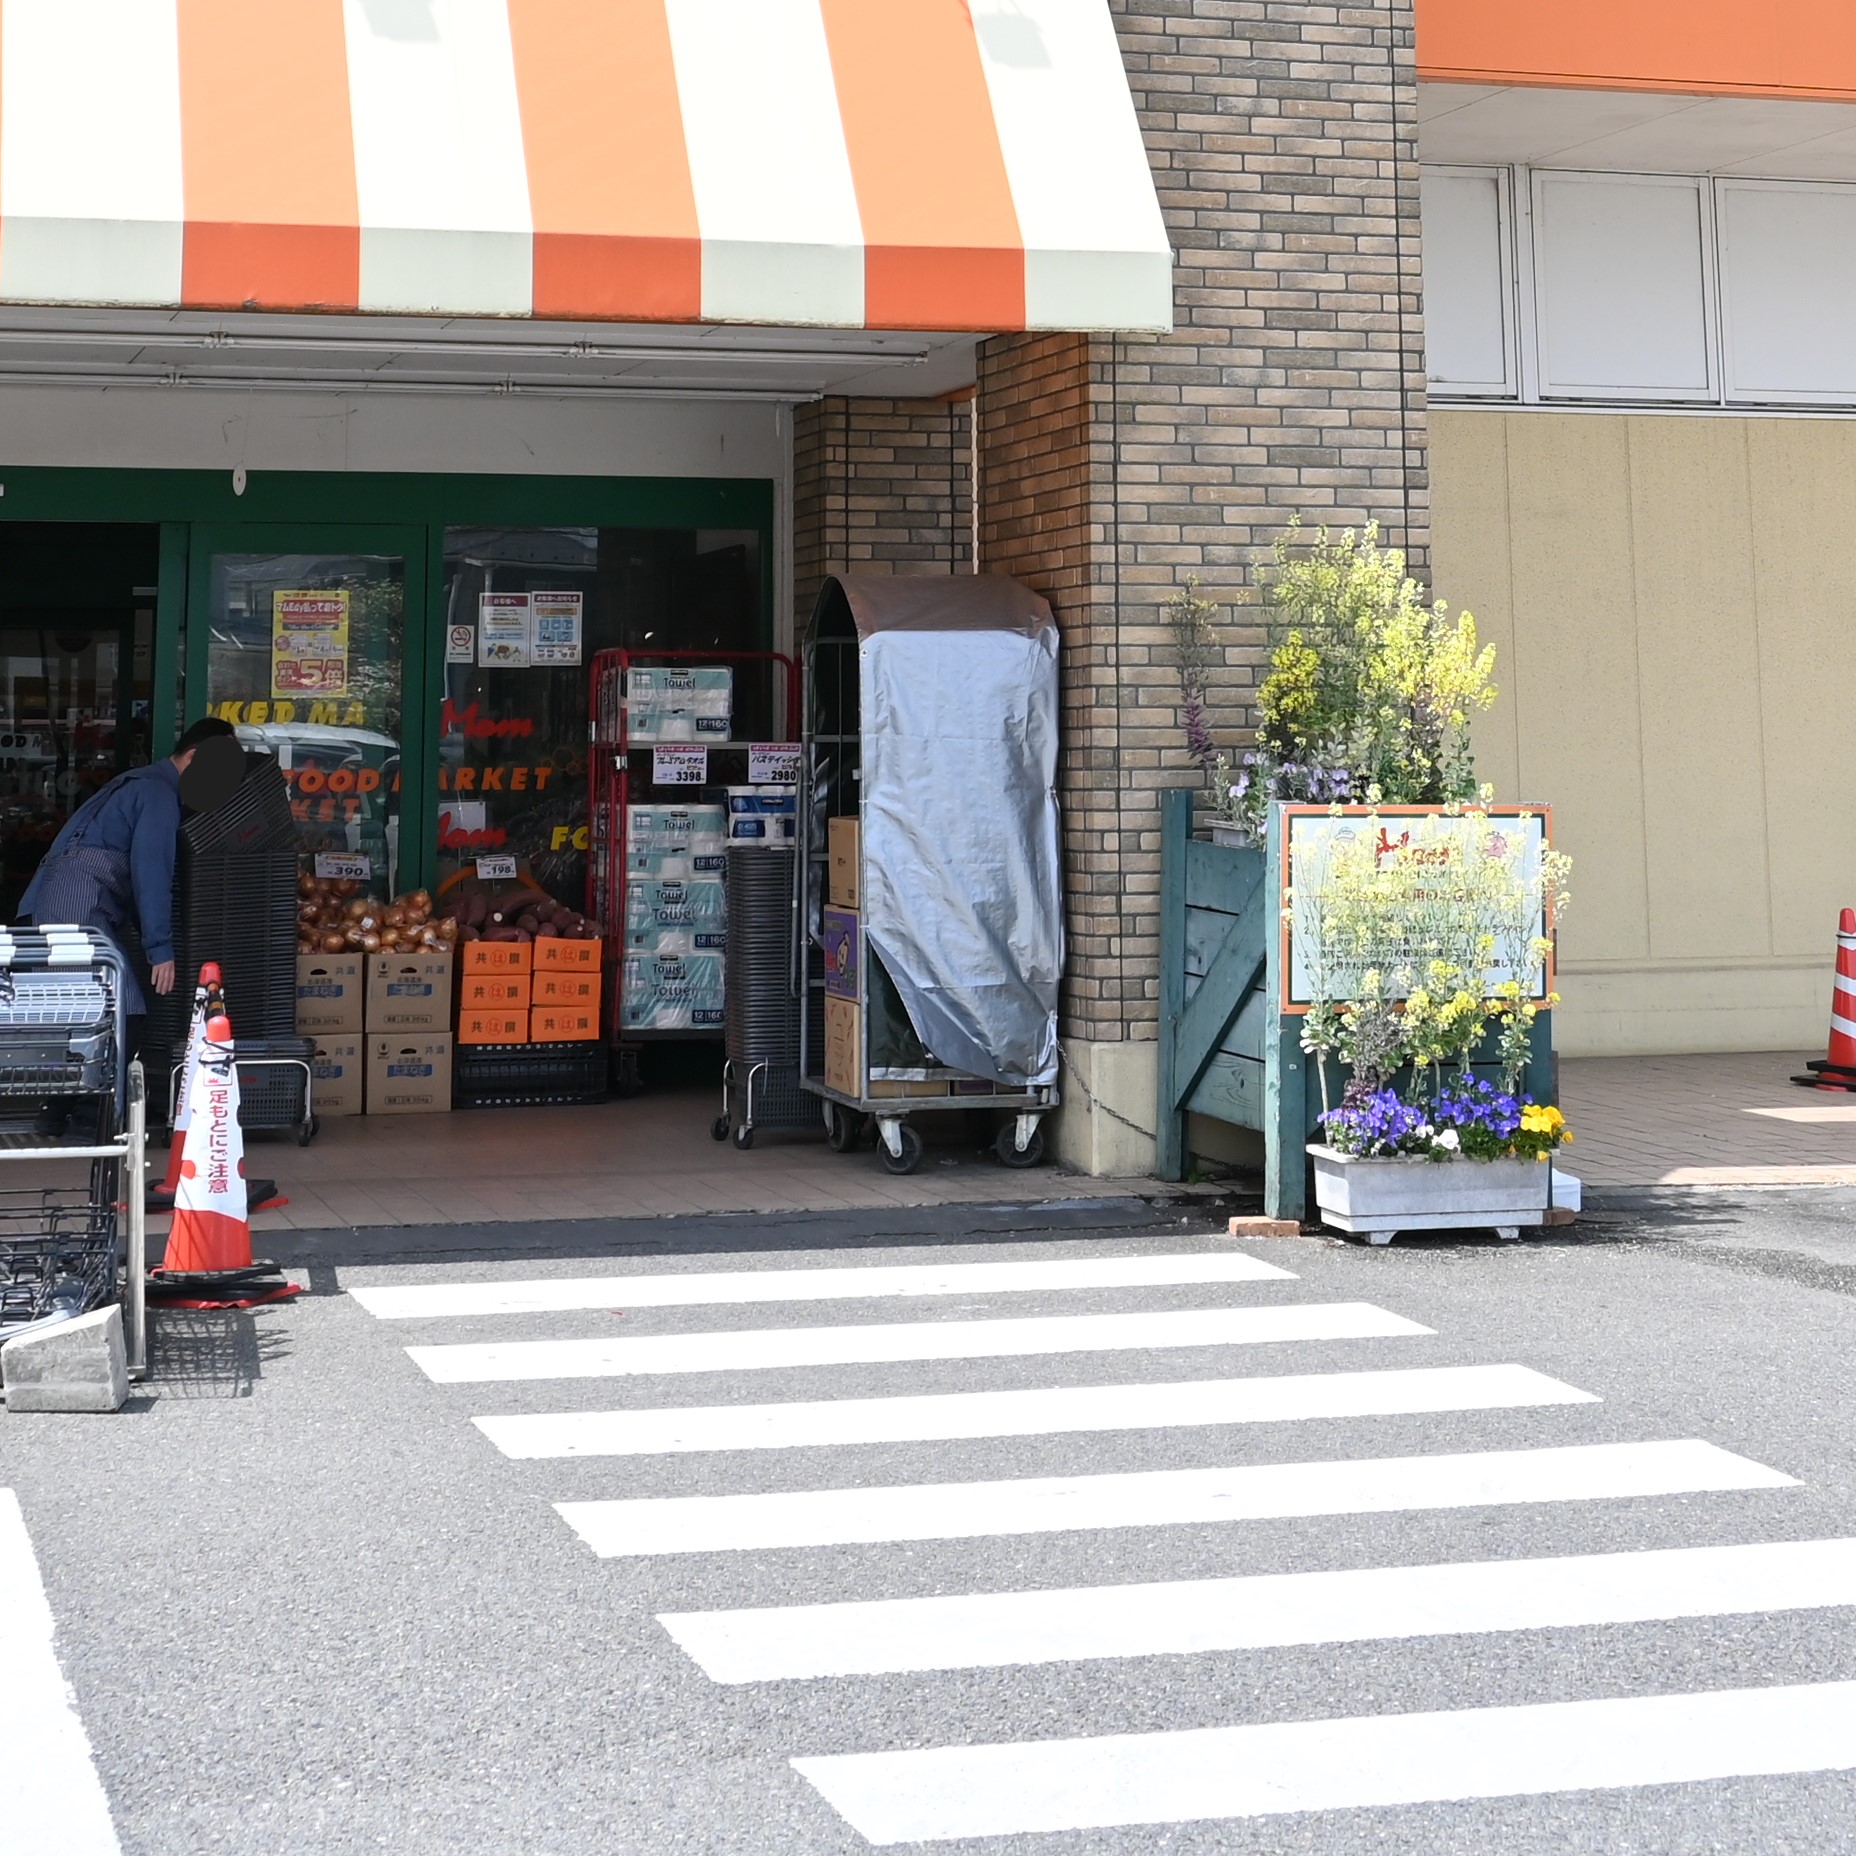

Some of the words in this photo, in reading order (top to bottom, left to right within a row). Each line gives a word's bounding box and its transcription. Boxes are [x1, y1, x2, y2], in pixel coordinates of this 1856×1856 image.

[300, 659, 324, 686] 5
[663, 676, 696, 690] Towel
[675, 771, 702, 782] 3398
[770, 770, 797, 781] 2980
[663, 819, 695, 831] Towel
[695, 858, 705, 867] 12
[708, 858, 725, 867] 160
[333, 866, 364, 876] 390
[491, 865, 512, 875] 198
[655, 889, 688, 901] Towel
[652, 907, 696, 921] Towel
[652, 962, 686, 974] Towel
[694, 1011, 703, 1021] 12
[207, 1089, 229, 1195] 足もとにご注意
